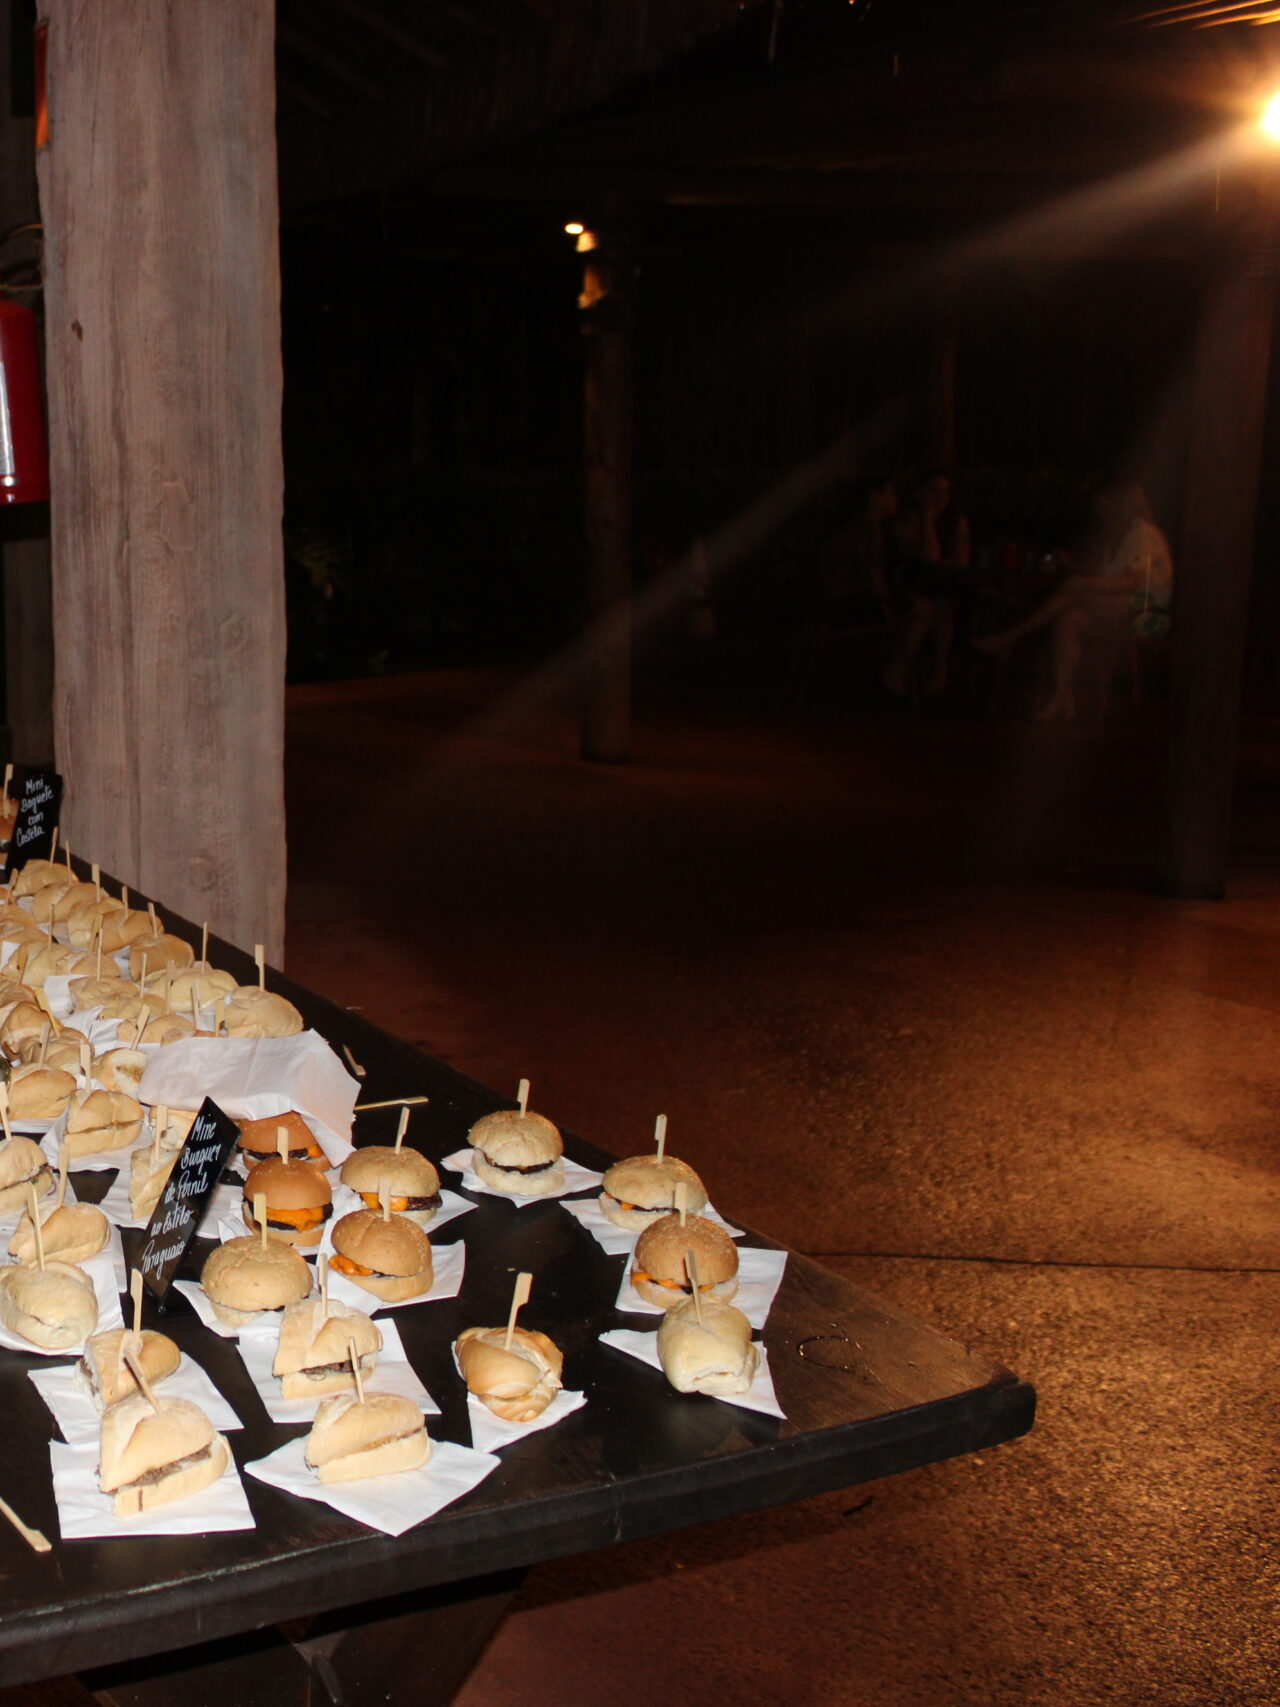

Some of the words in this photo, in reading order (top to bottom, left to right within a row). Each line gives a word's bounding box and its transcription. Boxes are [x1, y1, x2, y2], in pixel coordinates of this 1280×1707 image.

[25, 774, 44, 795] Mini
[28, 811, 44, 826] com
[165, 1180, 176, 1204] de
